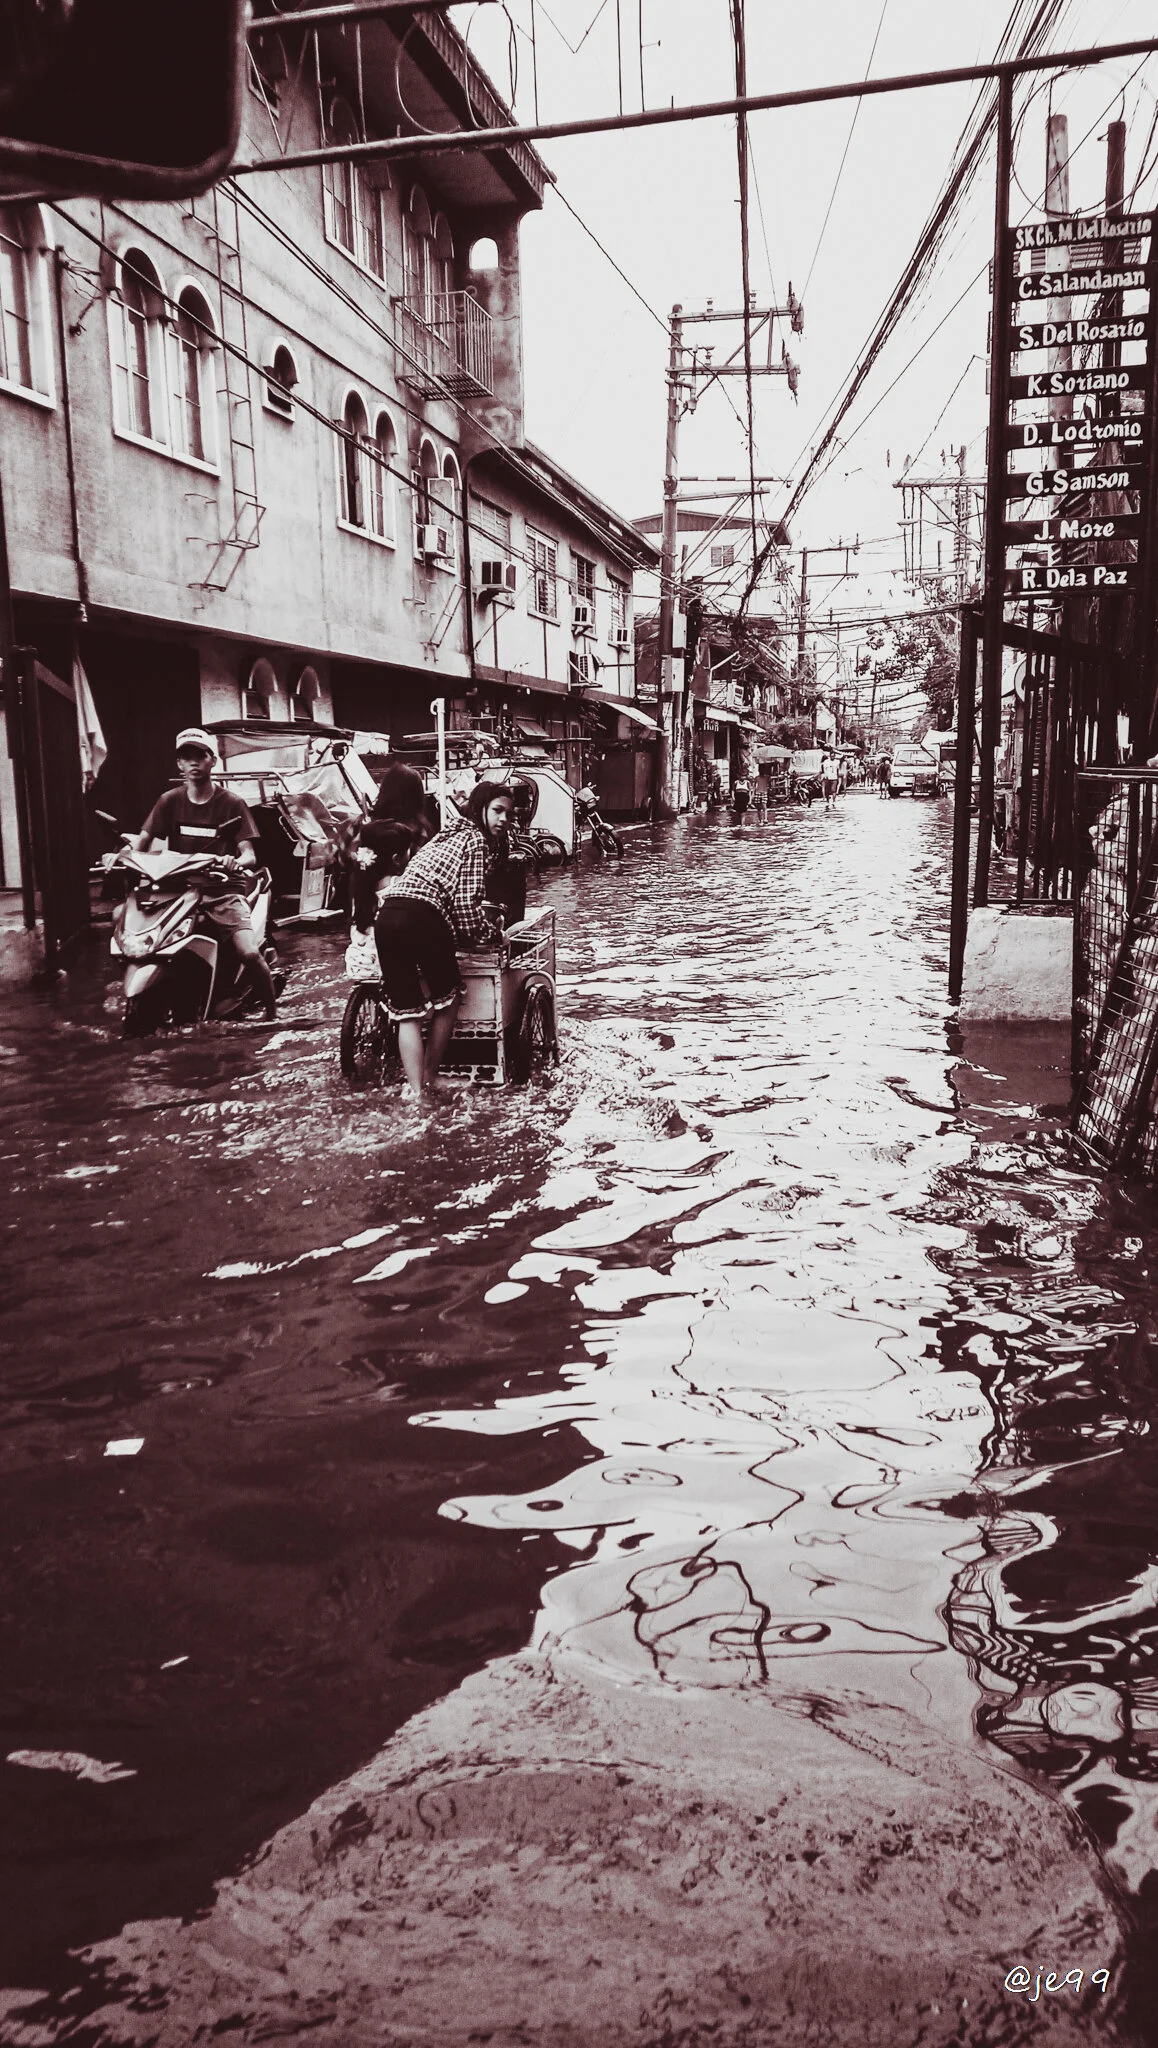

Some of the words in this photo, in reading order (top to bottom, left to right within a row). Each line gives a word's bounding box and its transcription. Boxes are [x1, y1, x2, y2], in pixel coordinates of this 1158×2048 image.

[1077, 218, 1100, 241] Del
[1100, 216, 1152, 239] Rosario
[1018, 276, 1038, 299] C.
[1039, 269, 1145, 296] Salandanan
[1018, 326, 1040, 349] S.
[1042, 322, 1073, 346] Del
[1076, 318, 1145, 342] Rosario
[1027, 375, 1047, 397] K.
[1050, 372, 1129, 394] Soriano
[1023, 424, 1044, 446] D.
[1051, 419, 1141, 443] Lodronio
[1025, 472, 1050, 495] G.
[1052, 469, 1130, 494] Samson
[1034, 520, 1055, 541] J.
[1060, 519, 1115, 540] More
[1022, 569, 1042, 590] R.
[1046, 567, 1088, 588] Dela
[1093, 566, 1128, 586] Paz
